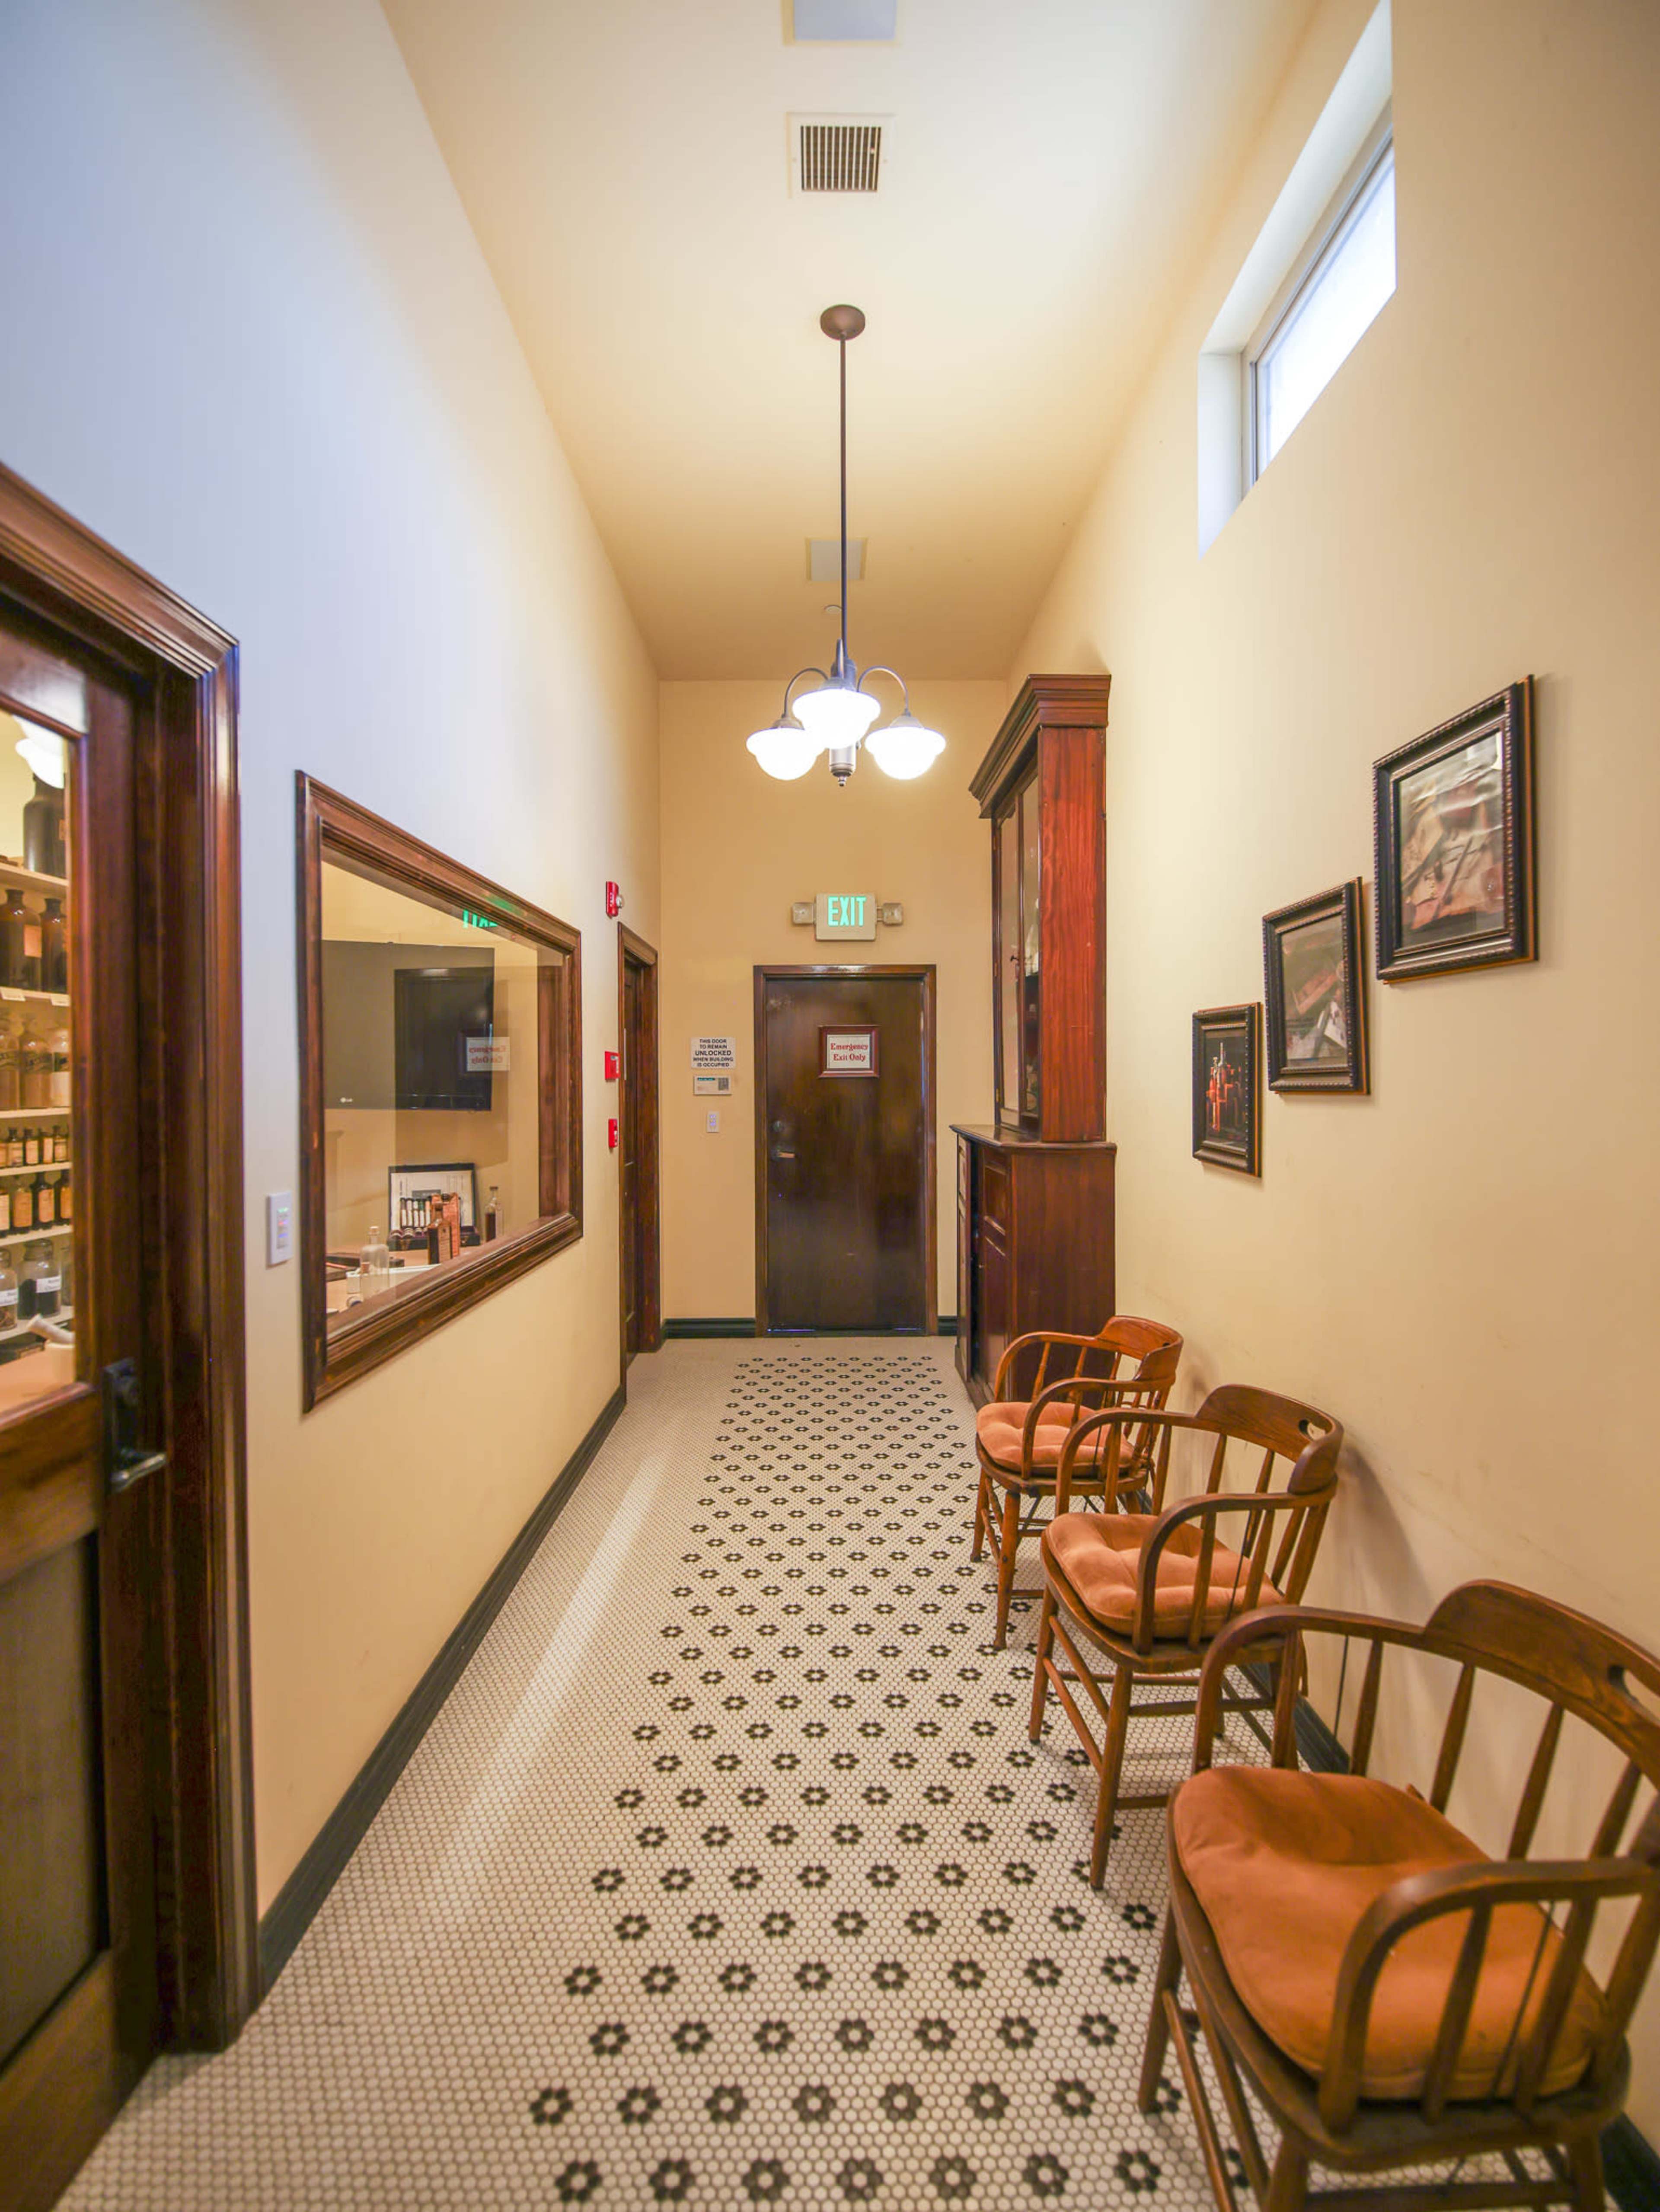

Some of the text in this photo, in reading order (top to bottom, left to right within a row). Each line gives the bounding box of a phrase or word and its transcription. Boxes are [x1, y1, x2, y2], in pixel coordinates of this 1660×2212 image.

[828, 896, 867, 927] EXIT
[830, 1043, 868, 1051] Emergency
[849, 1053, 866, 1062] Only
